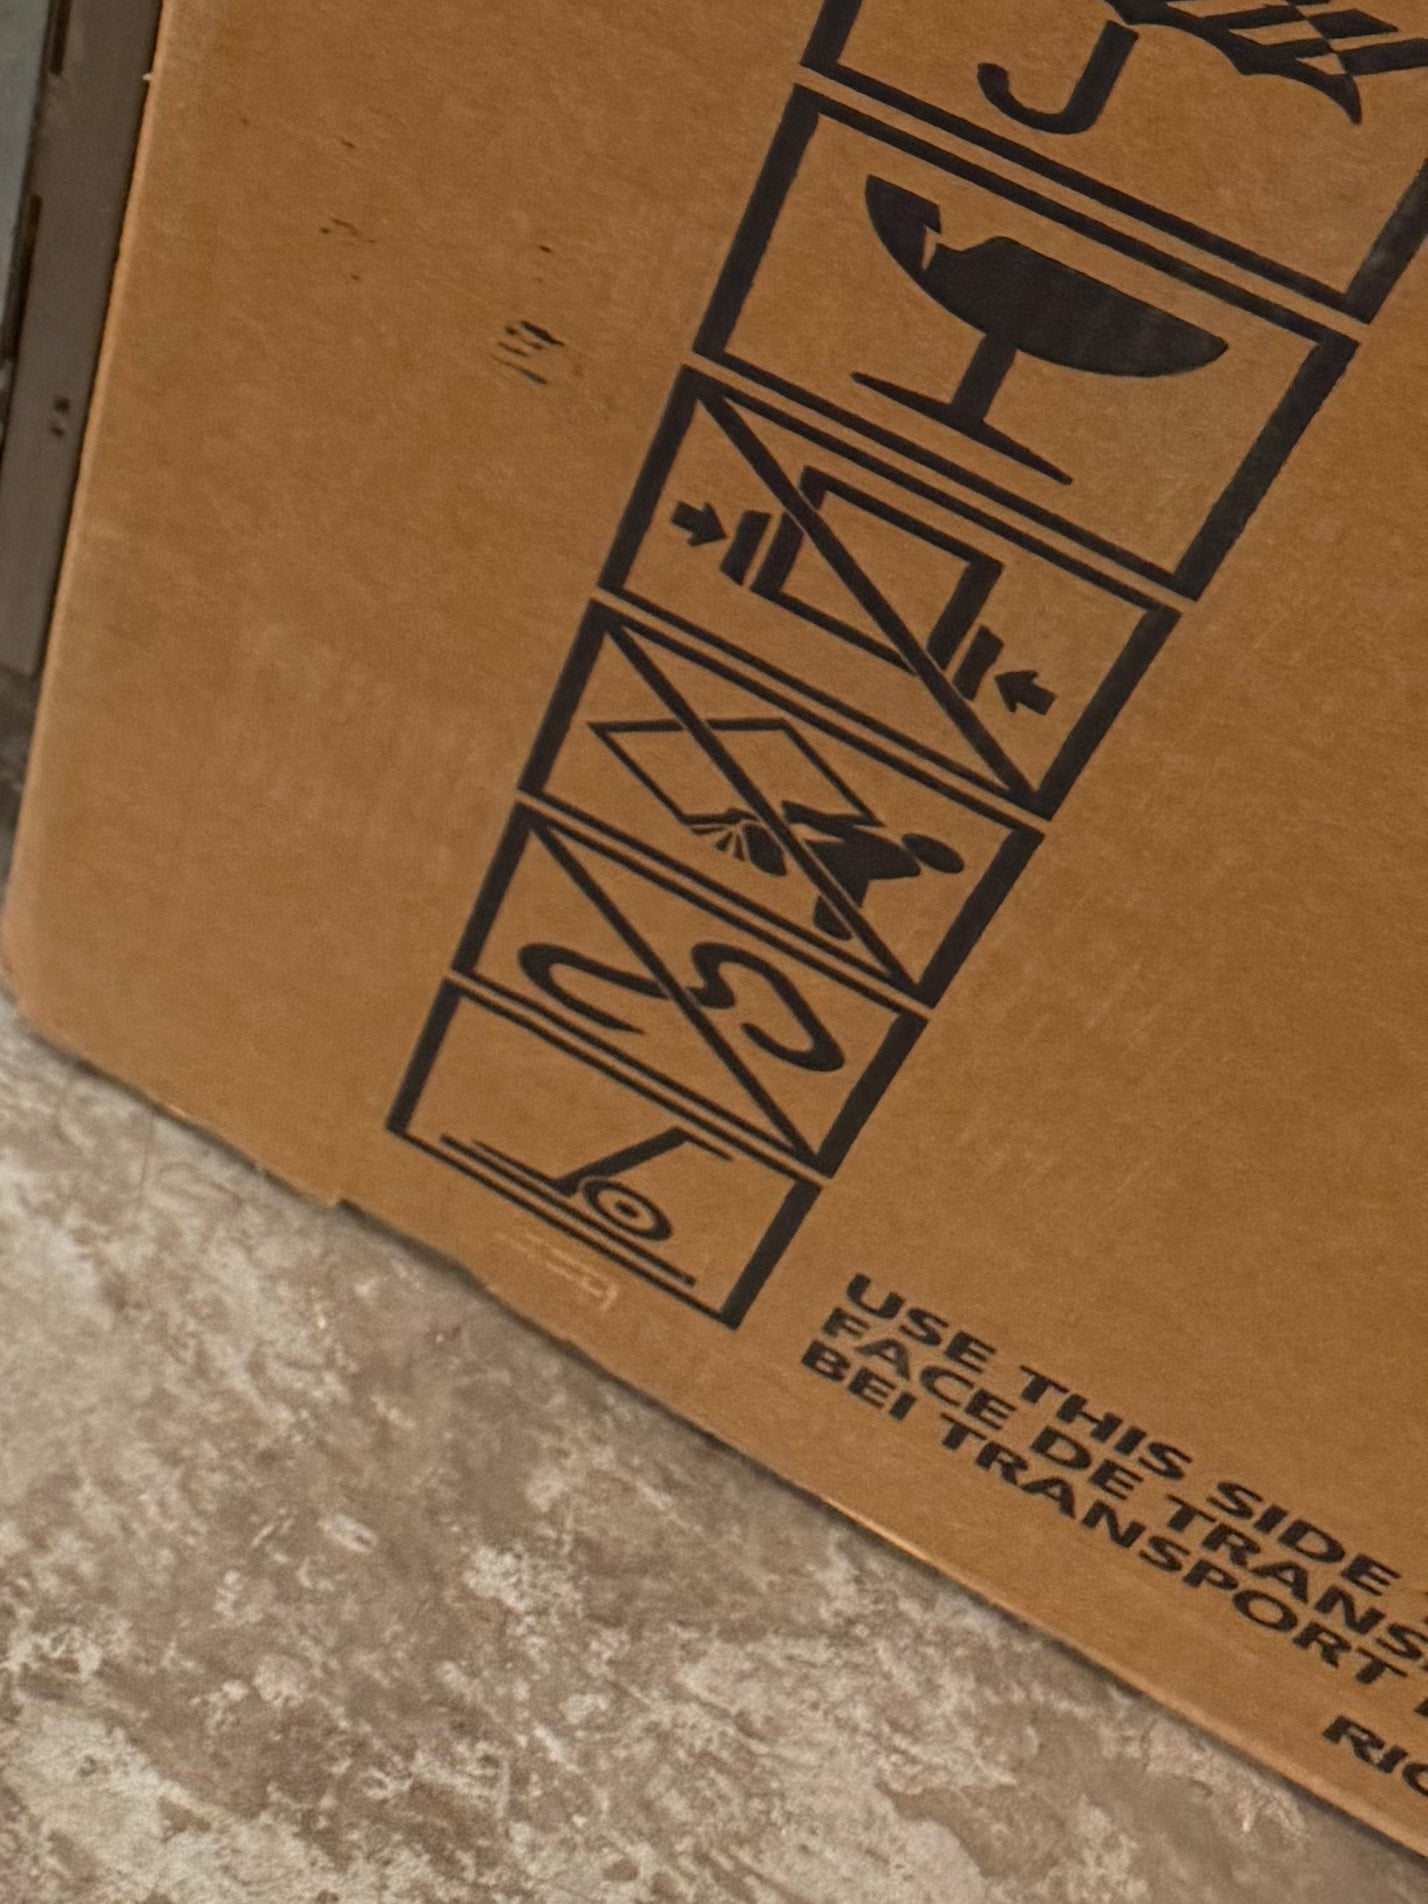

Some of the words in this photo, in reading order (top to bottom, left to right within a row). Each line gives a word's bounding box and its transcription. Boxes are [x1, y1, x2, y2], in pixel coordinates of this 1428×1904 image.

[801, 1340, 918, 1422] BEI
[940, 1413, 1408, 1686] TRANSPORT
[820, 1306, 1017, 1432] FACE
[1030, 1426, 1145, 1500] DE
[1166, 1494, 1428, 1670] TRANS
[846, 1274, 997, 1375] USE
[1020, 1364, 1193, 1482] THIS
[1207, 1481, 1401, 1597] SIDE
